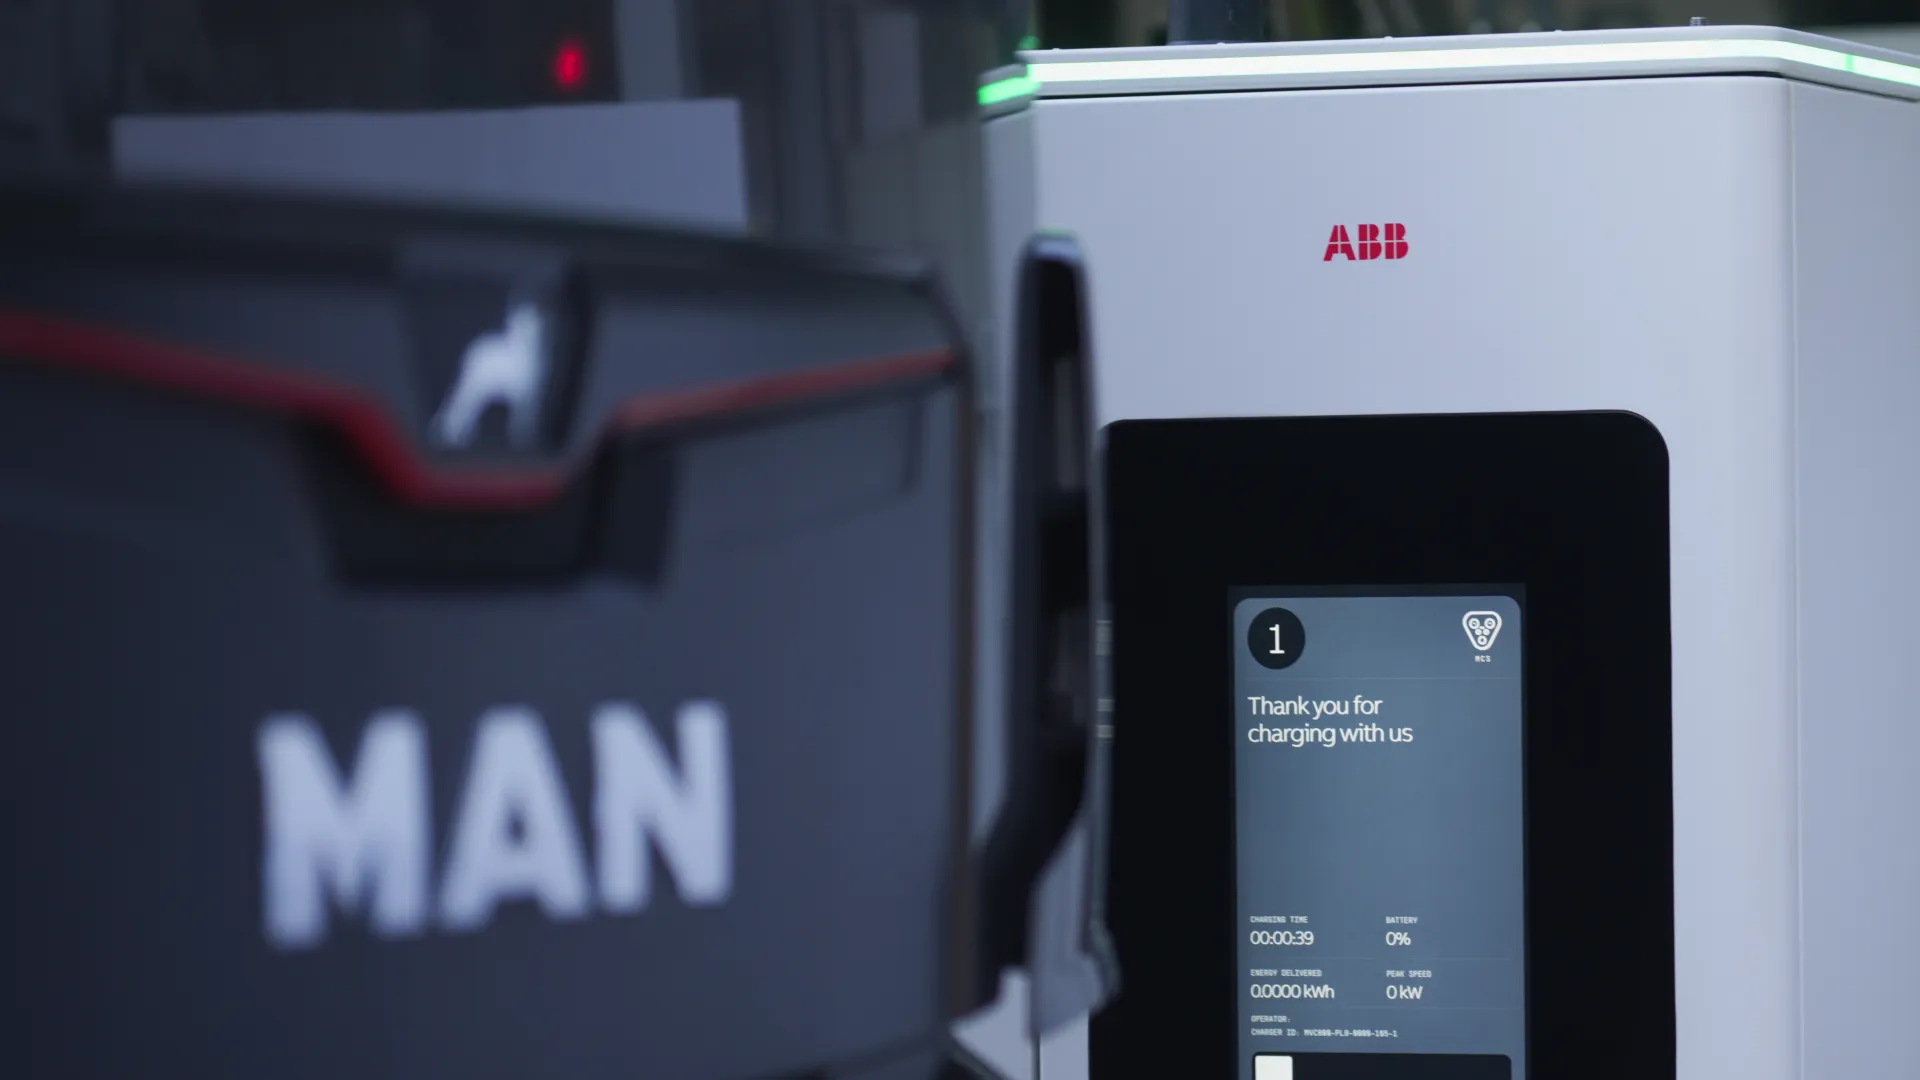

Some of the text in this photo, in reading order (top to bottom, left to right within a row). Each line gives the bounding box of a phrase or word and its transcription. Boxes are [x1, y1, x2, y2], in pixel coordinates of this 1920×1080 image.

[1323, 222, 1410, 262] ABB
[1268, 623, 1286, 655] 1
[1474, 654, 1492, 664] MCS
[1247, 694, 1384, 720] Thank you for
[1247, 722, 1414, 748] charging with us
[259, 699, 733, 948] MAN
[1250, 915, 1309, 924] CHARGING TIME
[1385, 915, 1419, 925] BATTERY
[1250, 930, 1315, 946] 00:00:39
[1385, 931, 1412, 946] 0%
[1250, 968, 1323, 977] ENERGY DELIVERED
[1385, 969, 1433, 978] PEAK SPEED
[1250, 983, 1335, 999] 0.0000 kWh
[1385, 984, 1424, 1000] 0 kW
[1250, 1014, 1291, 1023] OPERATOR:
[1250, 1028, 1283, 1036] CHARGER
